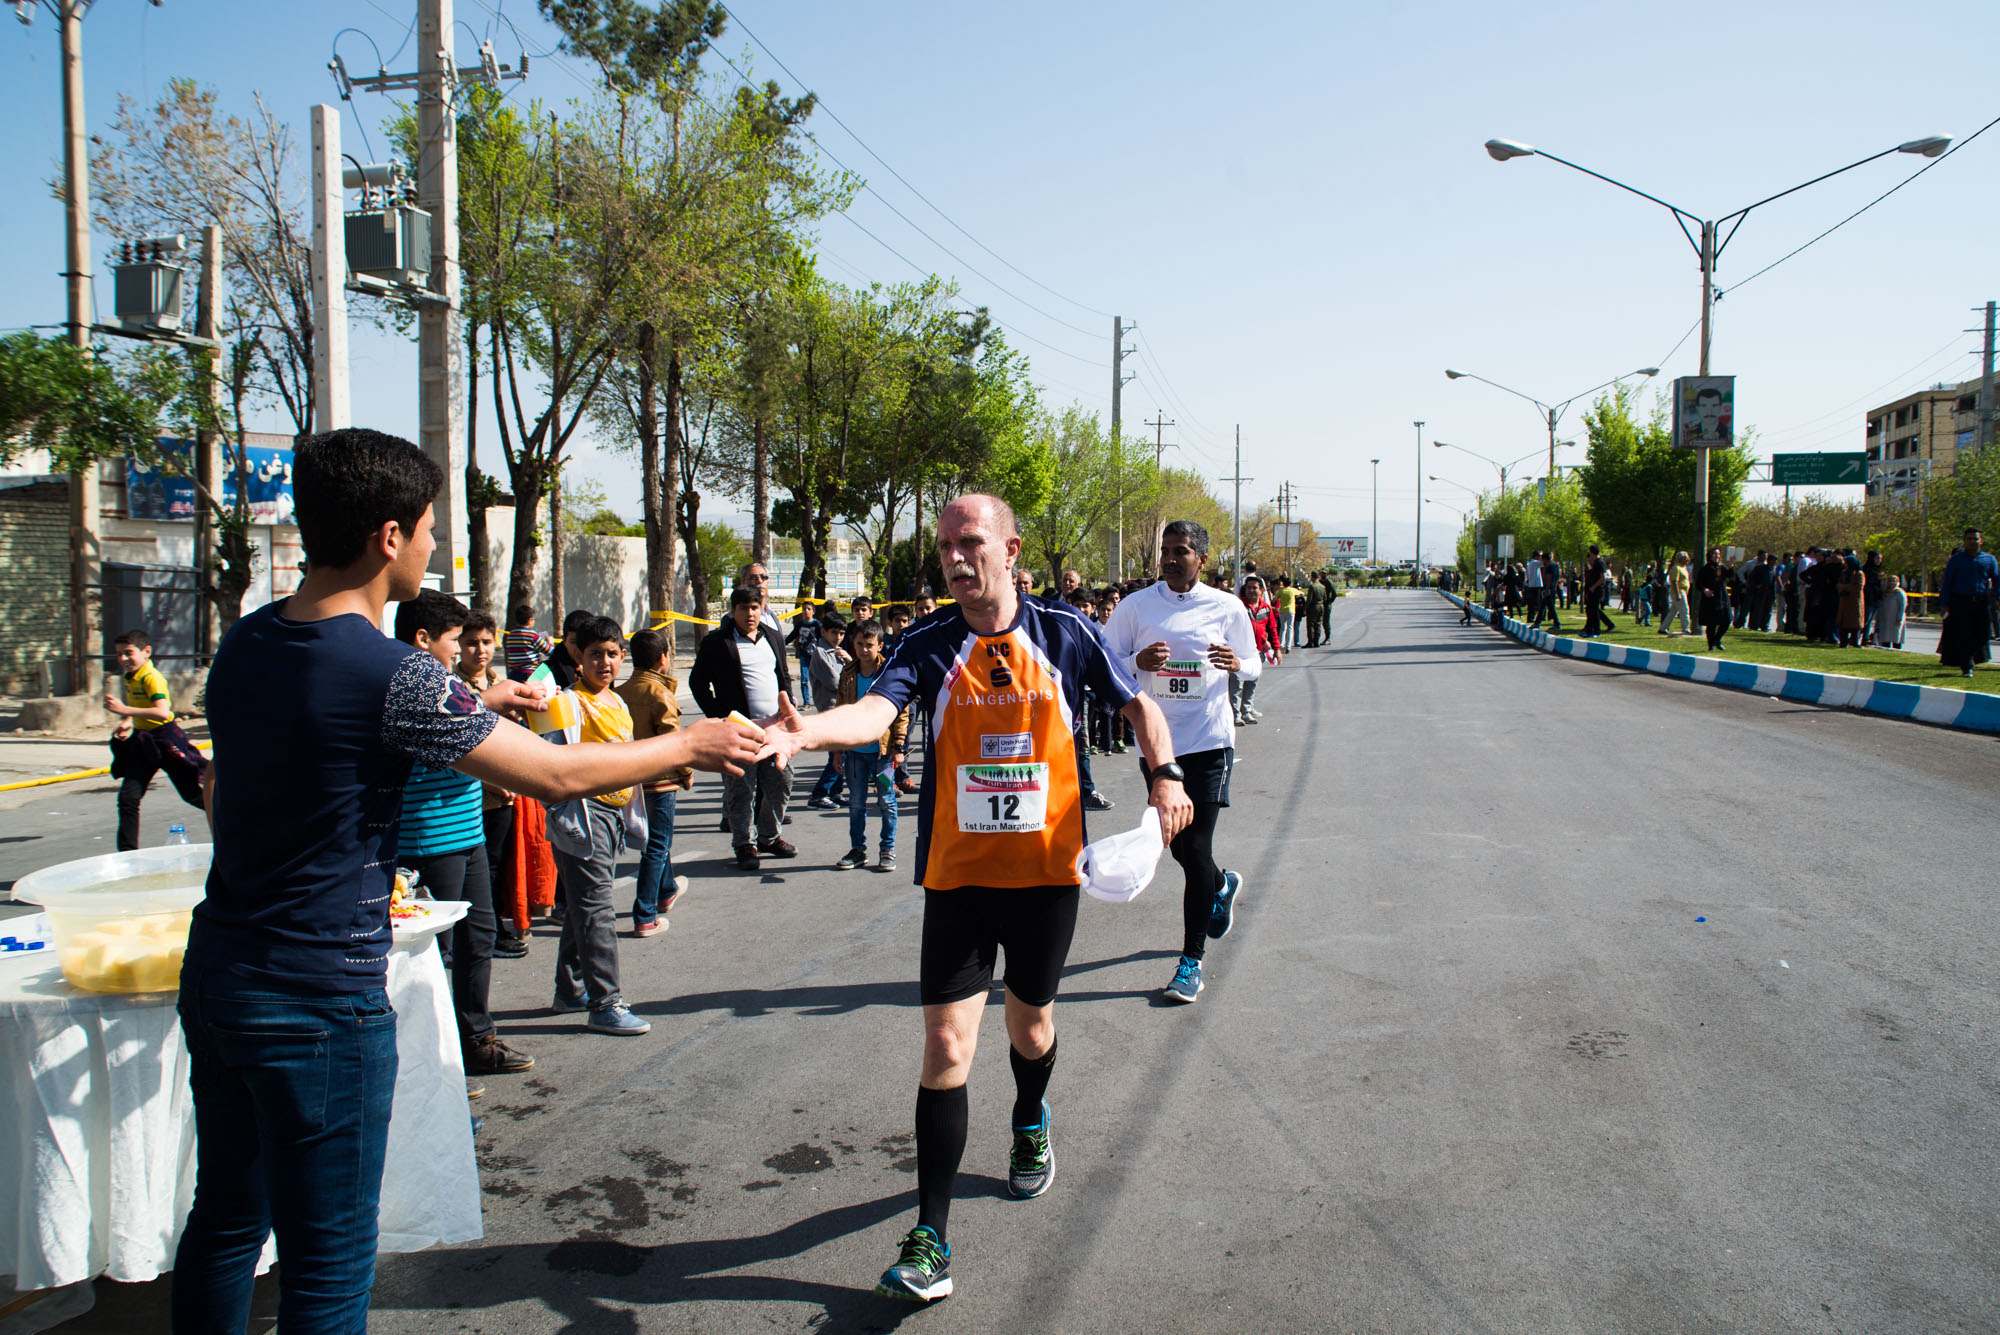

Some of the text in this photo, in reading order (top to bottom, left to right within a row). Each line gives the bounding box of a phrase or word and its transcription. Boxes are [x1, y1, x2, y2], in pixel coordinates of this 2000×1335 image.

[1169, 678, 1189, 694] 99
[956, 688, 1055, 706] LANGENLOIS
[1006, 781, 1023, 789] Iran
[987, 794, 1020, 821] 12
[964, 821, 1040, 831] 1st Iran Marathon
